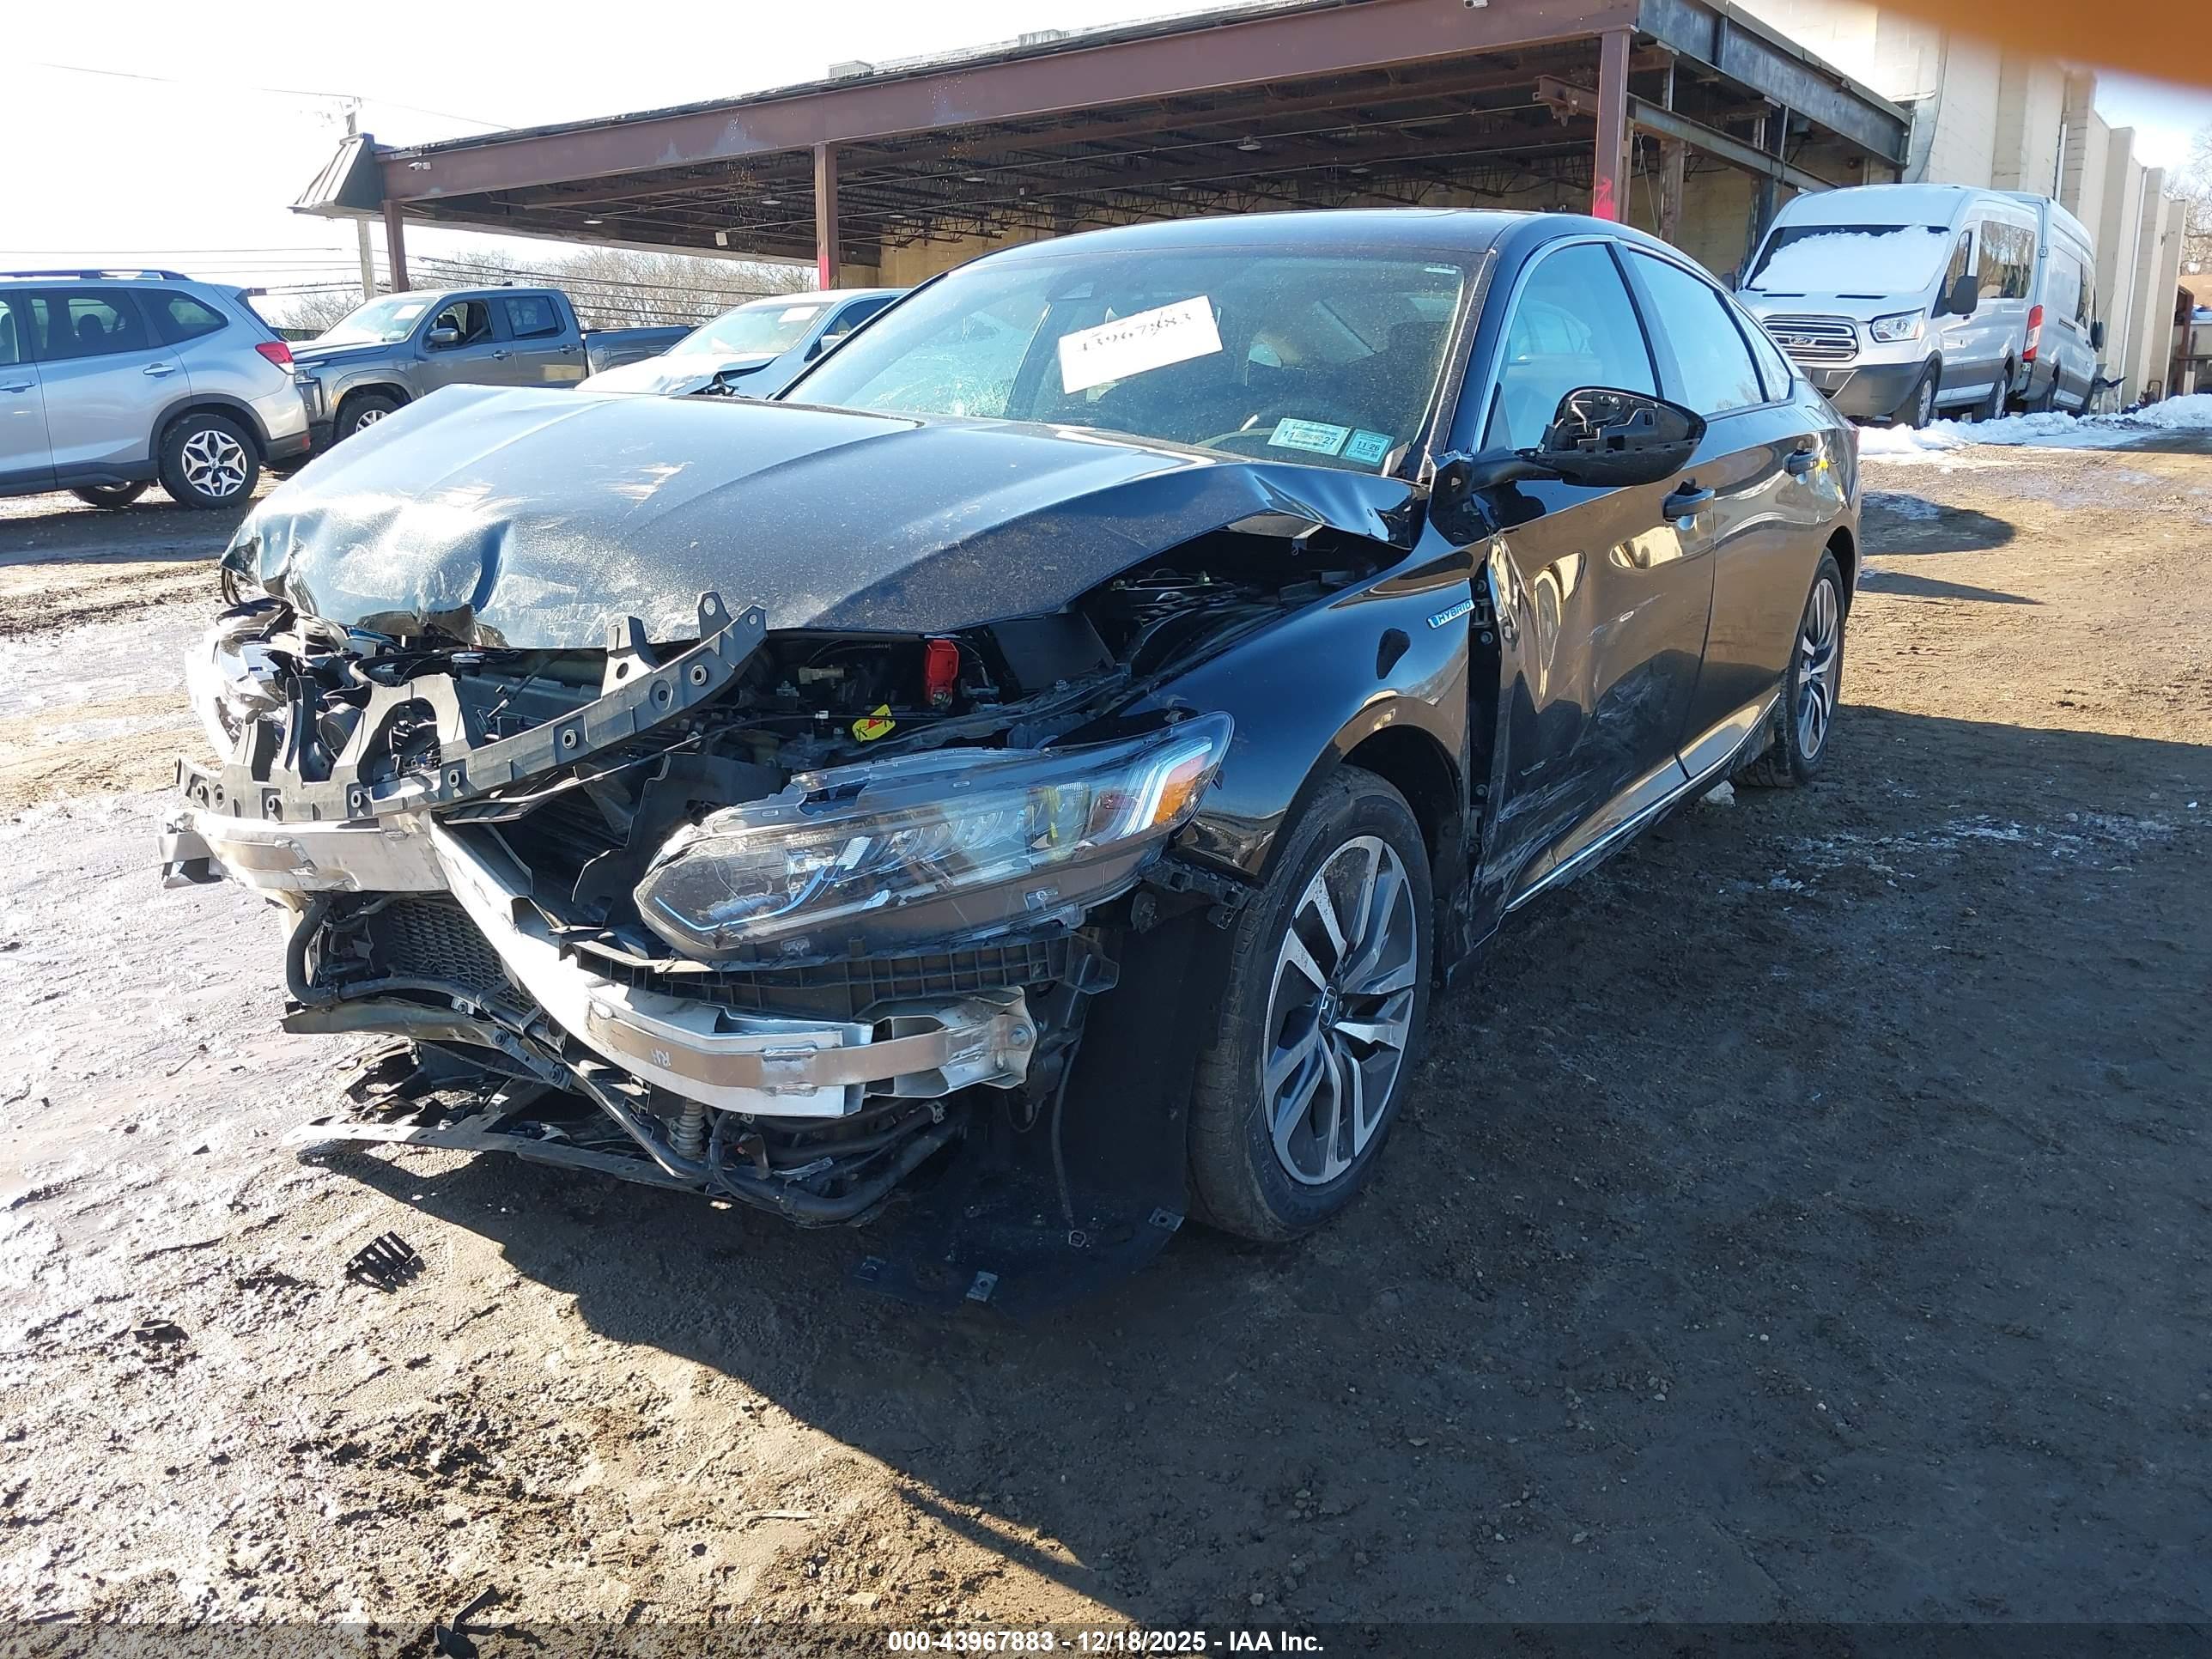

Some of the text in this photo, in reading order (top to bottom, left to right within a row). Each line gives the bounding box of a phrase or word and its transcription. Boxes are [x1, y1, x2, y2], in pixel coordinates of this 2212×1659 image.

[1283, 430, 1293, 440] 11
[1322, 436, 1339, 446] 27
[1357, 441, 1381, 452] 11 26
[1437, 601, 1472, 624] HYBRID
